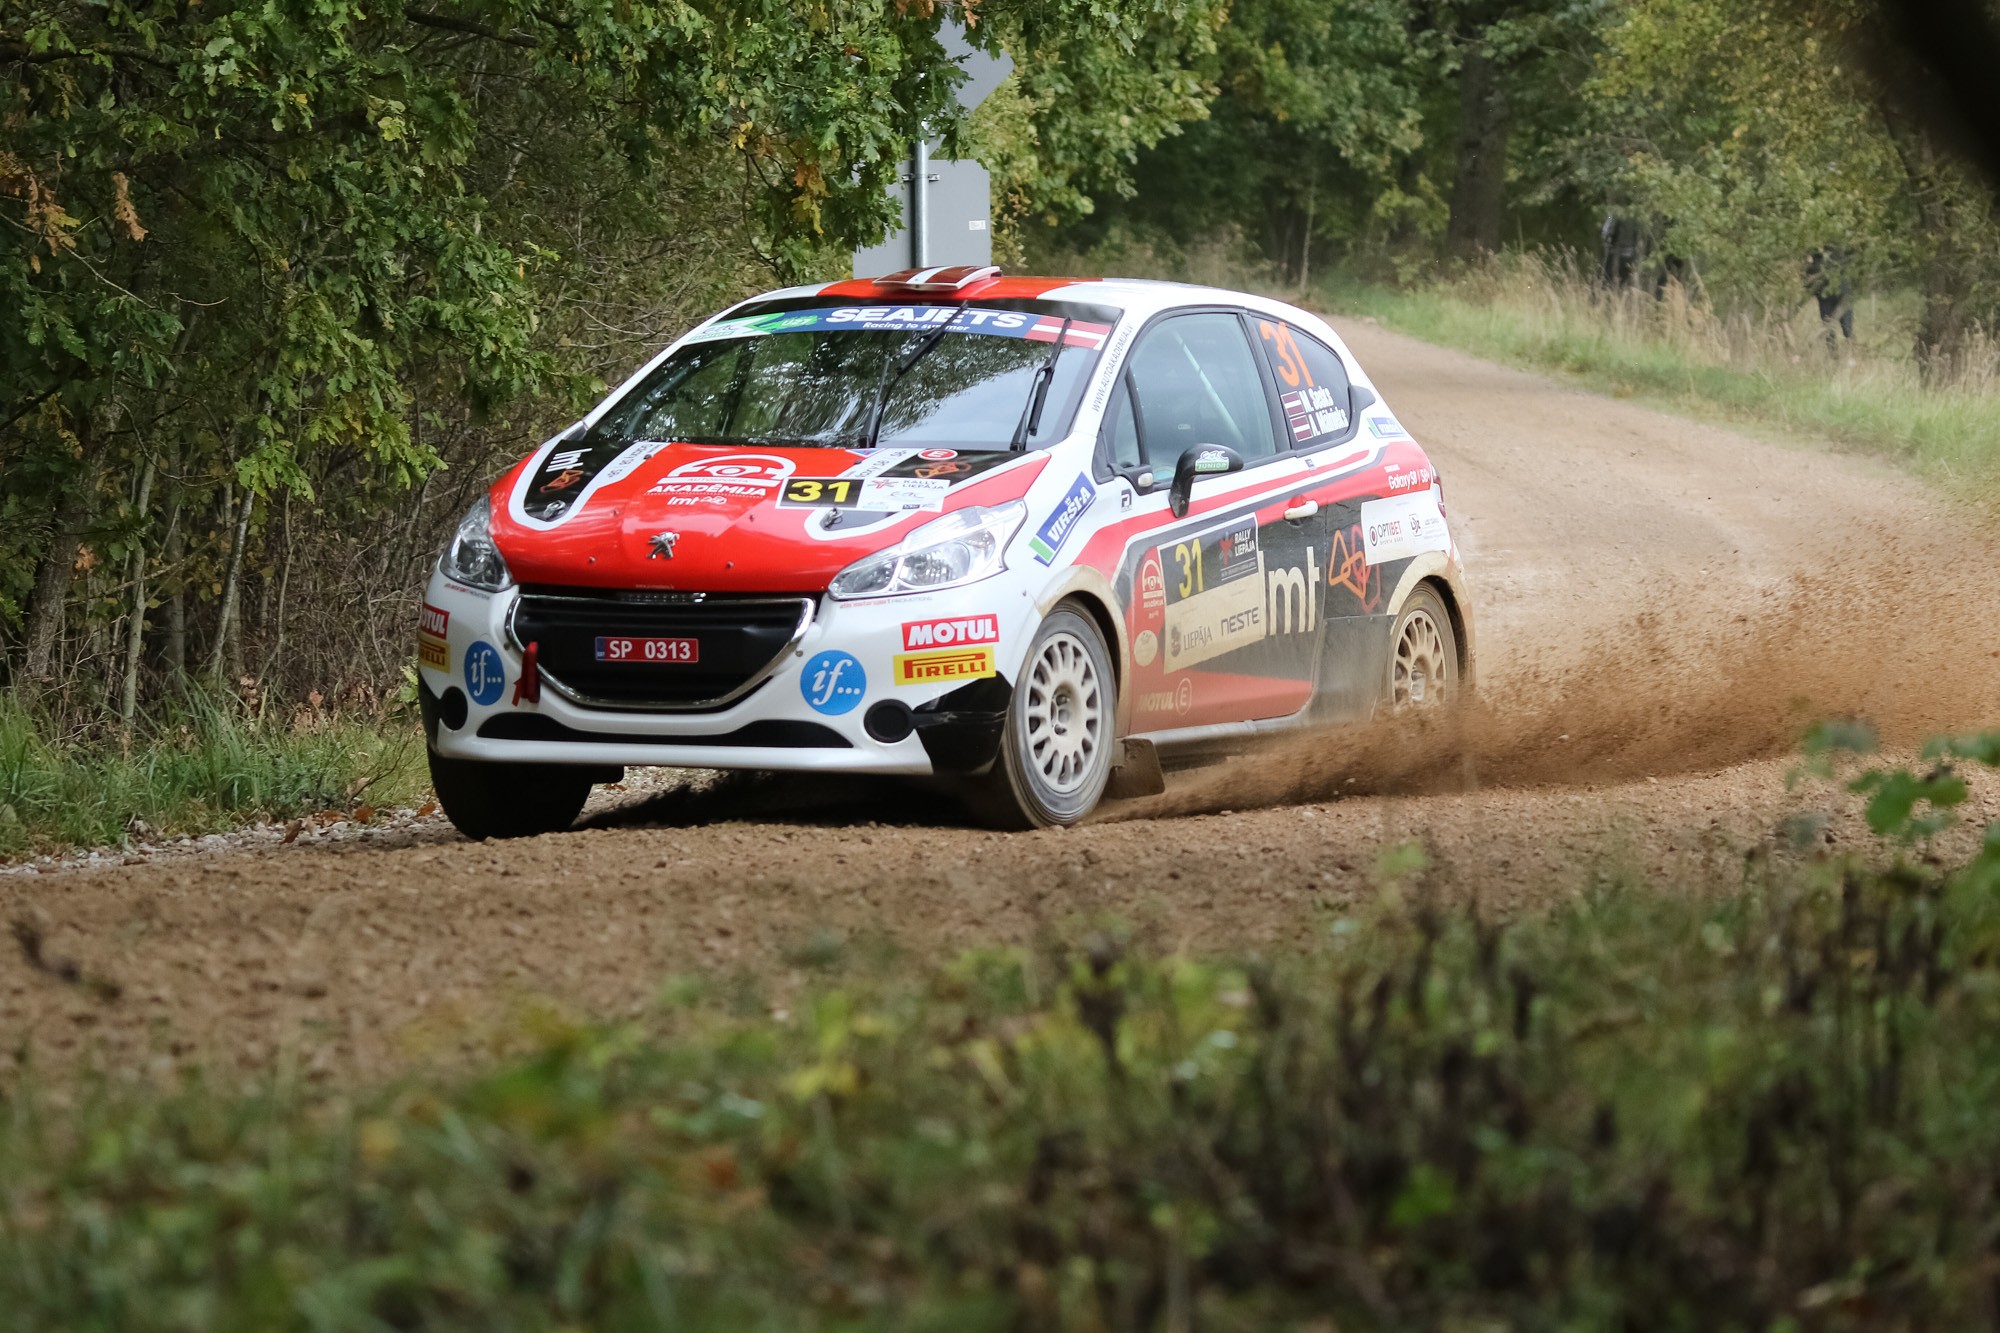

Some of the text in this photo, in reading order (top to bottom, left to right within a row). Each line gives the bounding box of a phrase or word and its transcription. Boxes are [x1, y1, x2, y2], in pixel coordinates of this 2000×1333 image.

[825, 308, 1027, 328] SEAJETS
[862, 321, 906, 331] Racing
[1260, 320, 1314, 388] 31
[647, 484, 767, 496] AKADĒMIJA
[788, 481, 851, 503] 31
[1388, 474, 1410, 490] Galaxy
[1234, 528, 1252, 545] RALLY
[1377, 520, 1402, 538] OPTIBET
[1175, 538, 1204, 599] 31
[421, 608, 446, 634] OTUL
[1220, 606, 1260, 637] NESTE
[908, 618, 997, 647] MOTUL
[1183, 625, 1213, 651] LIEPĀJA
[609, 640, 691, 660] SP 0313
[904, 653, 986, 679] PIRELLI
[1138, 690, 1175, 712] MOTUL
